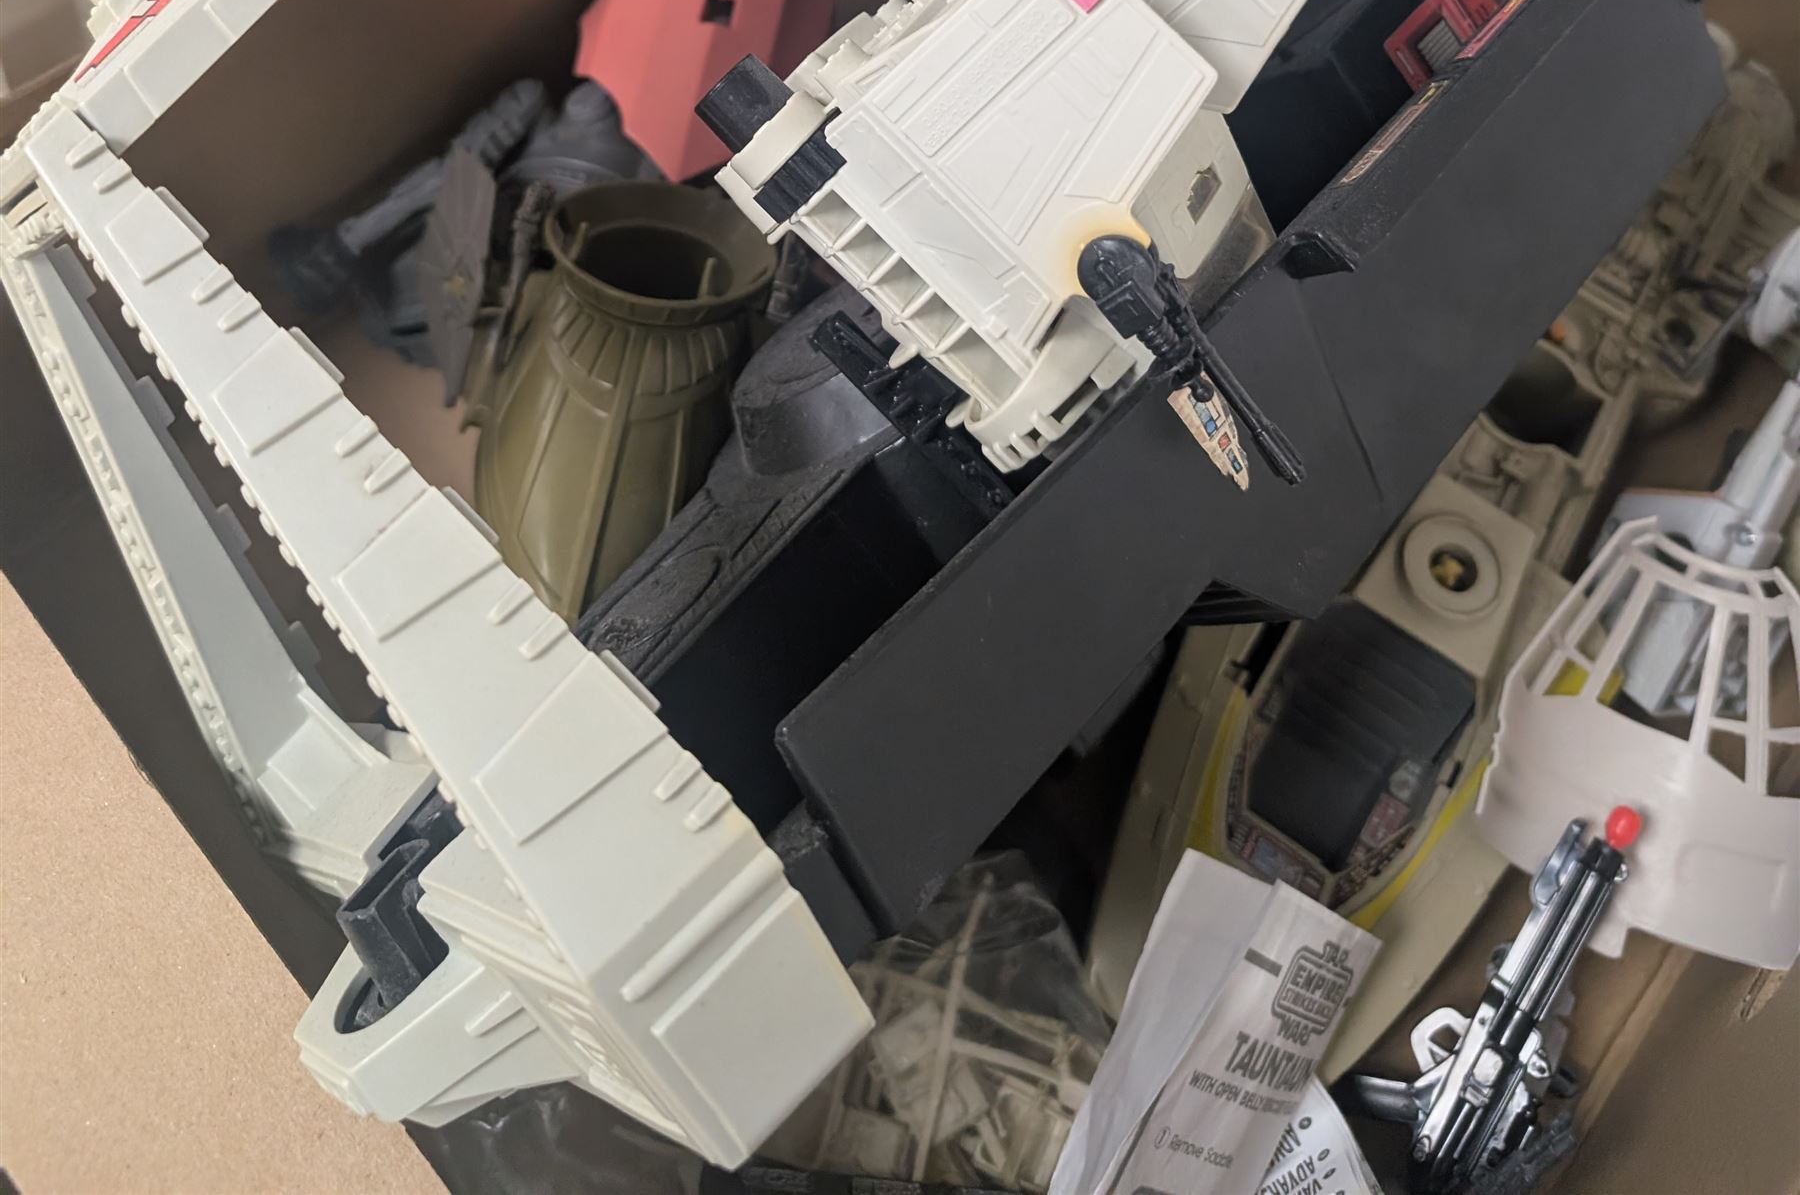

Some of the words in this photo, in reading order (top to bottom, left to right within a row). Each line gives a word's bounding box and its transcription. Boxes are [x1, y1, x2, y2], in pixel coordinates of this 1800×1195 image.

[1290, 965, 1347, 1003] EMPIRE
[1188, 1070, 1217, 1094] WITH
[1214, 1081, 1243, 1104] OPEN
